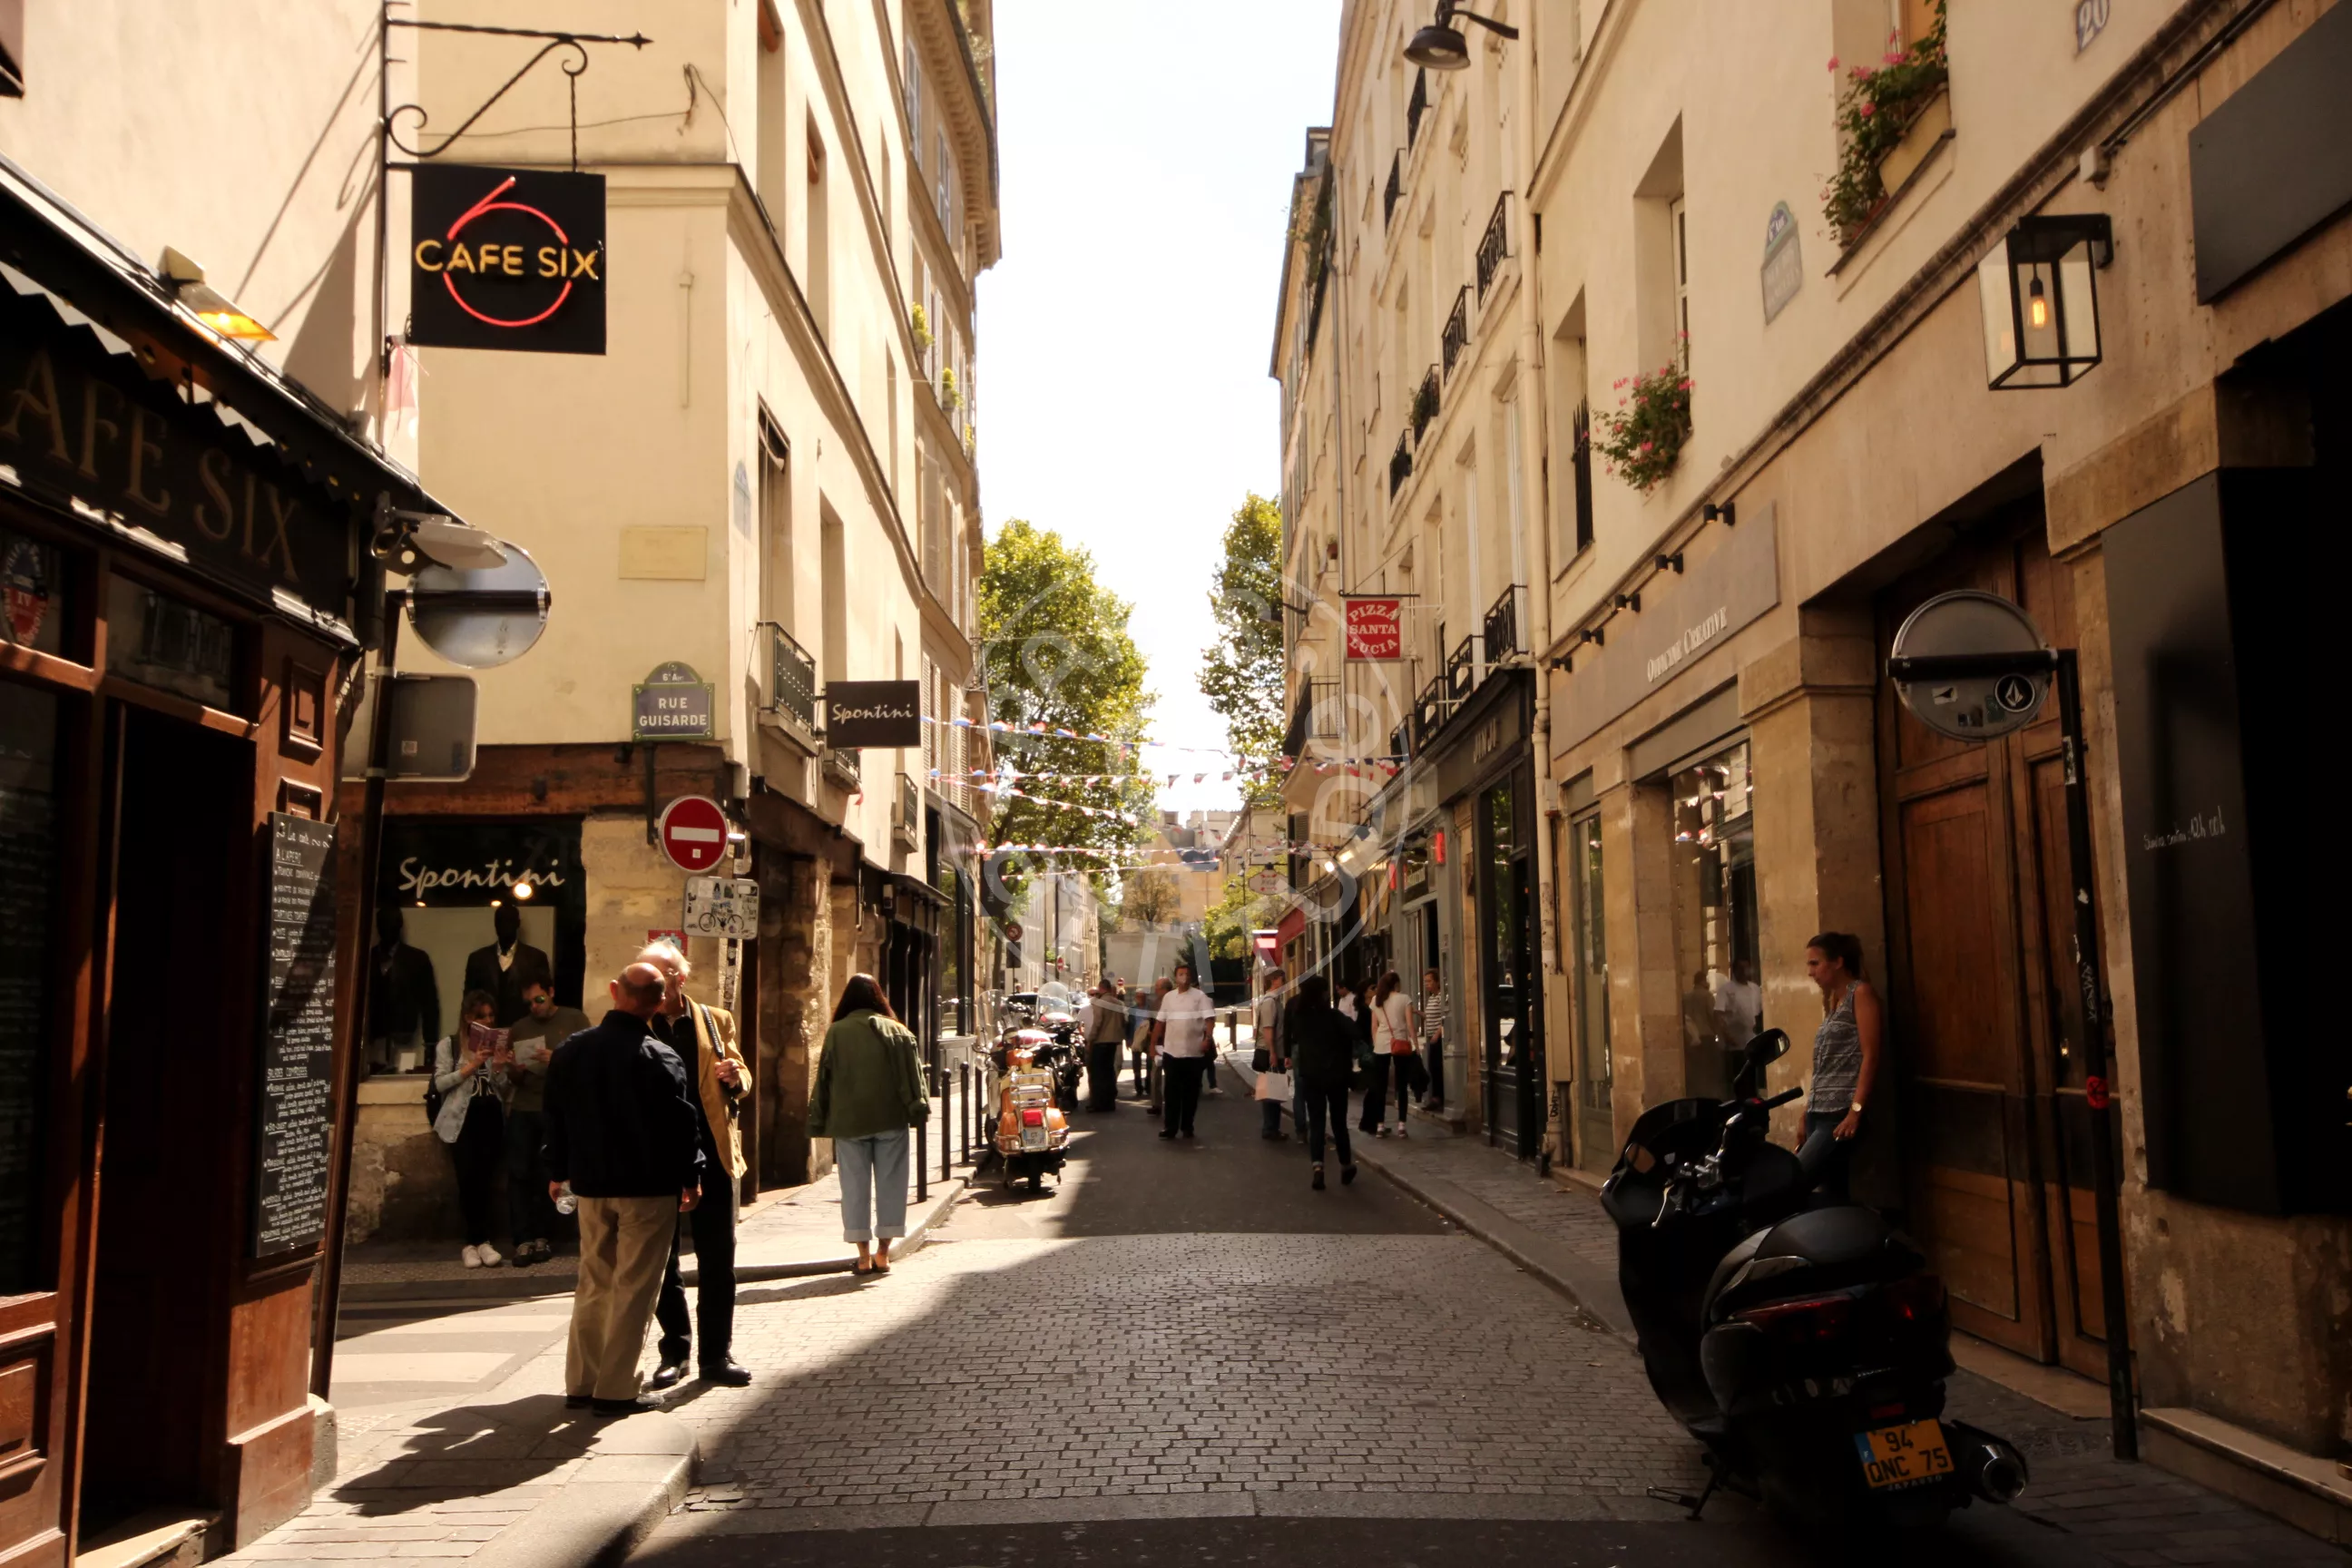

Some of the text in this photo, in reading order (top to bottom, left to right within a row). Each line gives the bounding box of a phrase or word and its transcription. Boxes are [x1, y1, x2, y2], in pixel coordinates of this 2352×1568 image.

[2080, 0, 2108, 47] 20
[416, 240, 600, 281] CAFE SIX
[1, 350, 301, 583] AFE SIX
[1348, 604, 1398, 622] PIZZA
[1349, 624, 1397, 634] SANTA
[1349, 638, 1398, 654] LUCIA
[659, 698, 688, 709] RUE
[832, 703, 914, 725] Spontini
[640, 714, 708, 727] GUISARDE
[399, 856, 565, 899] Spontini
[1885, 1430, 1914, 1452] 94
[1867, 1447, 1949, 1483] QNC 75
